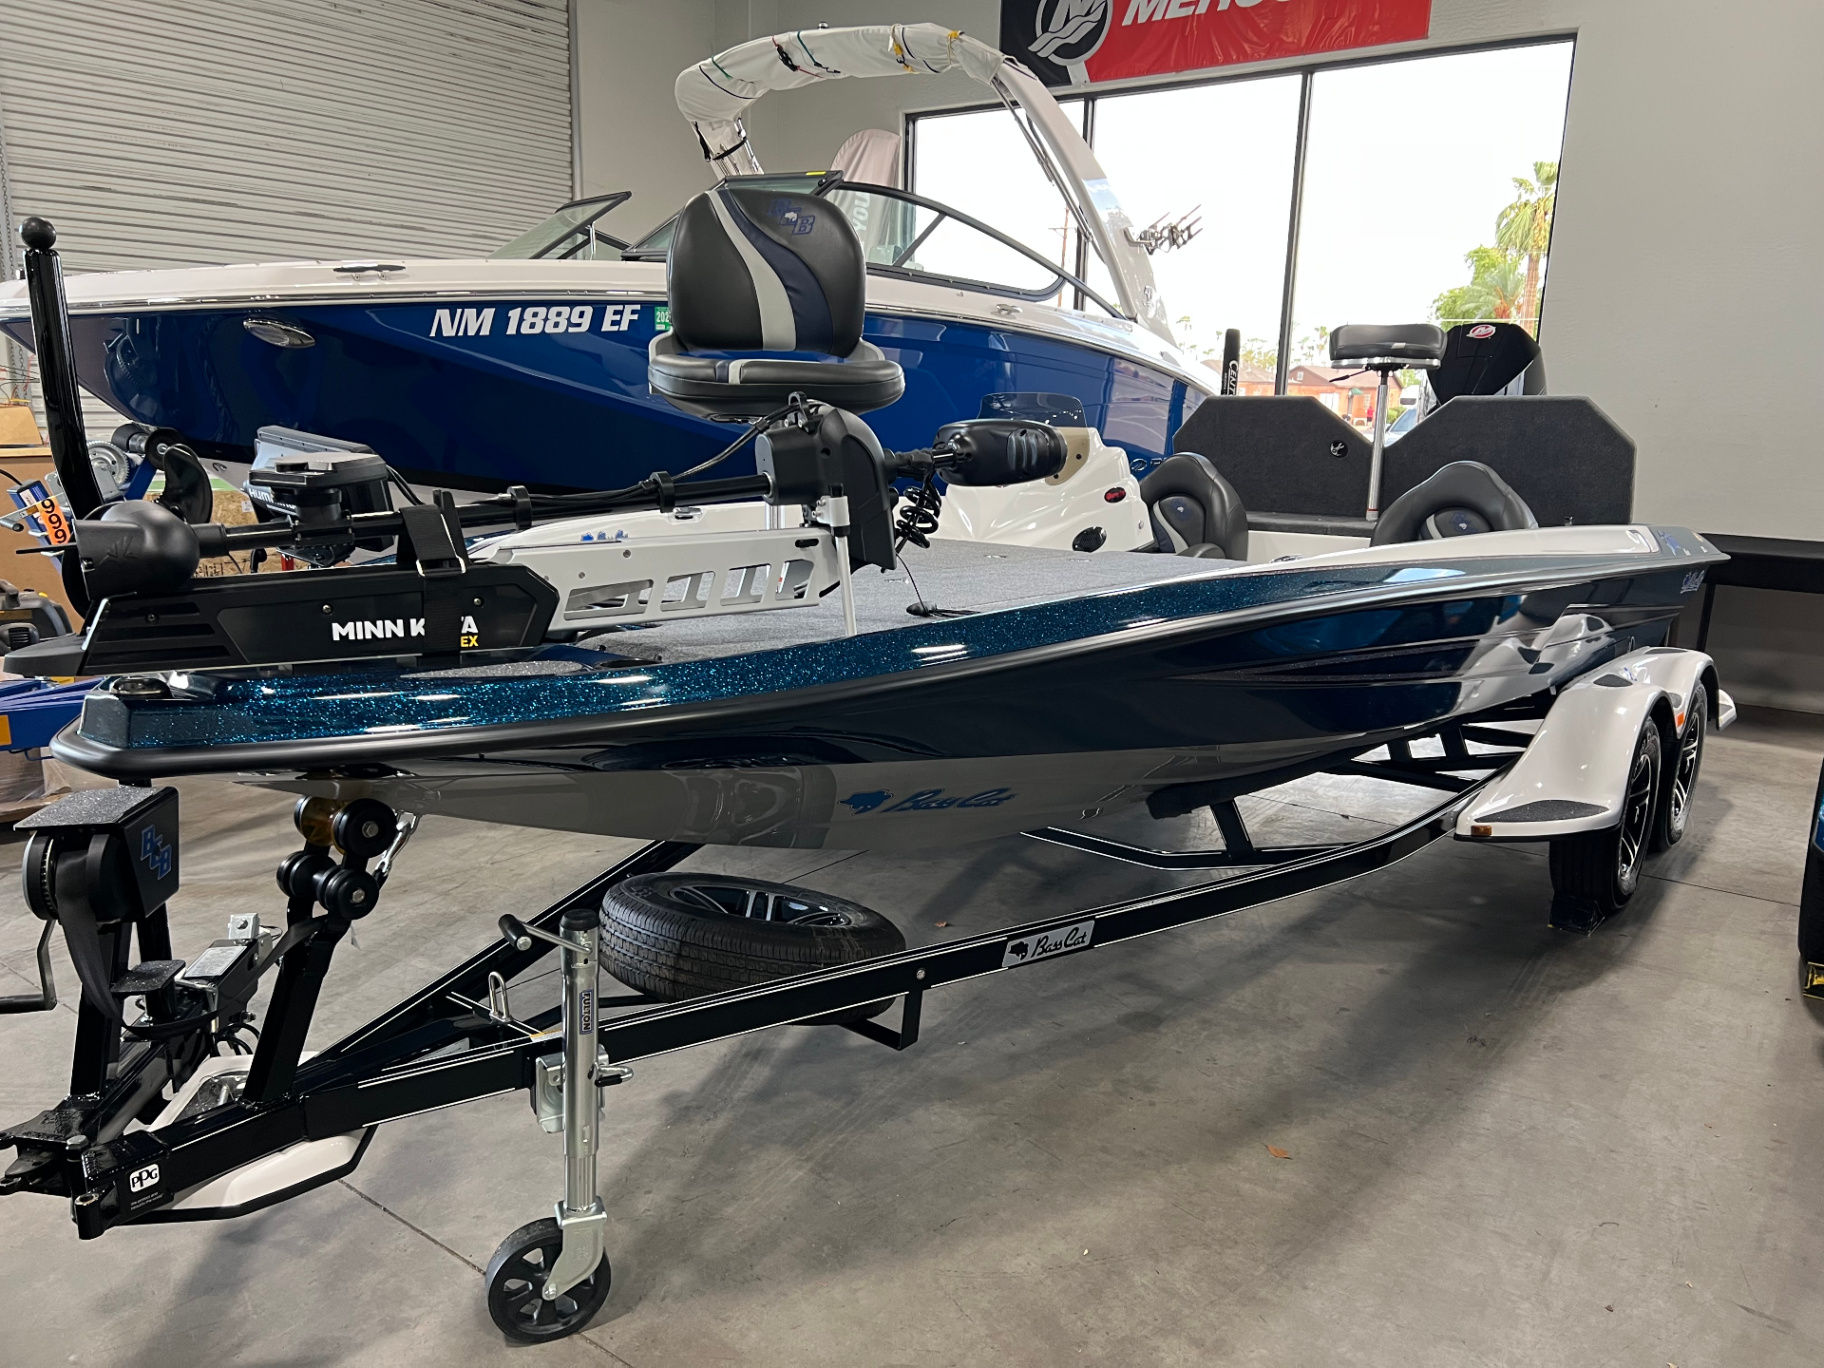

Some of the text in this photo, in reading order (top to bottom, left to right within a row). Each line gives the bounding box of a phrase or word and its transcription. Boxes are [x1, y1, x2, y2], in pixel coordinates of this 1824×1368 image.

[429, 304, 641, 337] NM 1889 EF
[656, 311, 671, 323] 202
[331, 615, 479, 641] MINN KA
[460, 635, 479, 647] EX
[1030, 927, 1087, 958] Bass Cat
[582, 992, 591, 1031] FULTON
[131, 1168, 158, 1188] PPG
